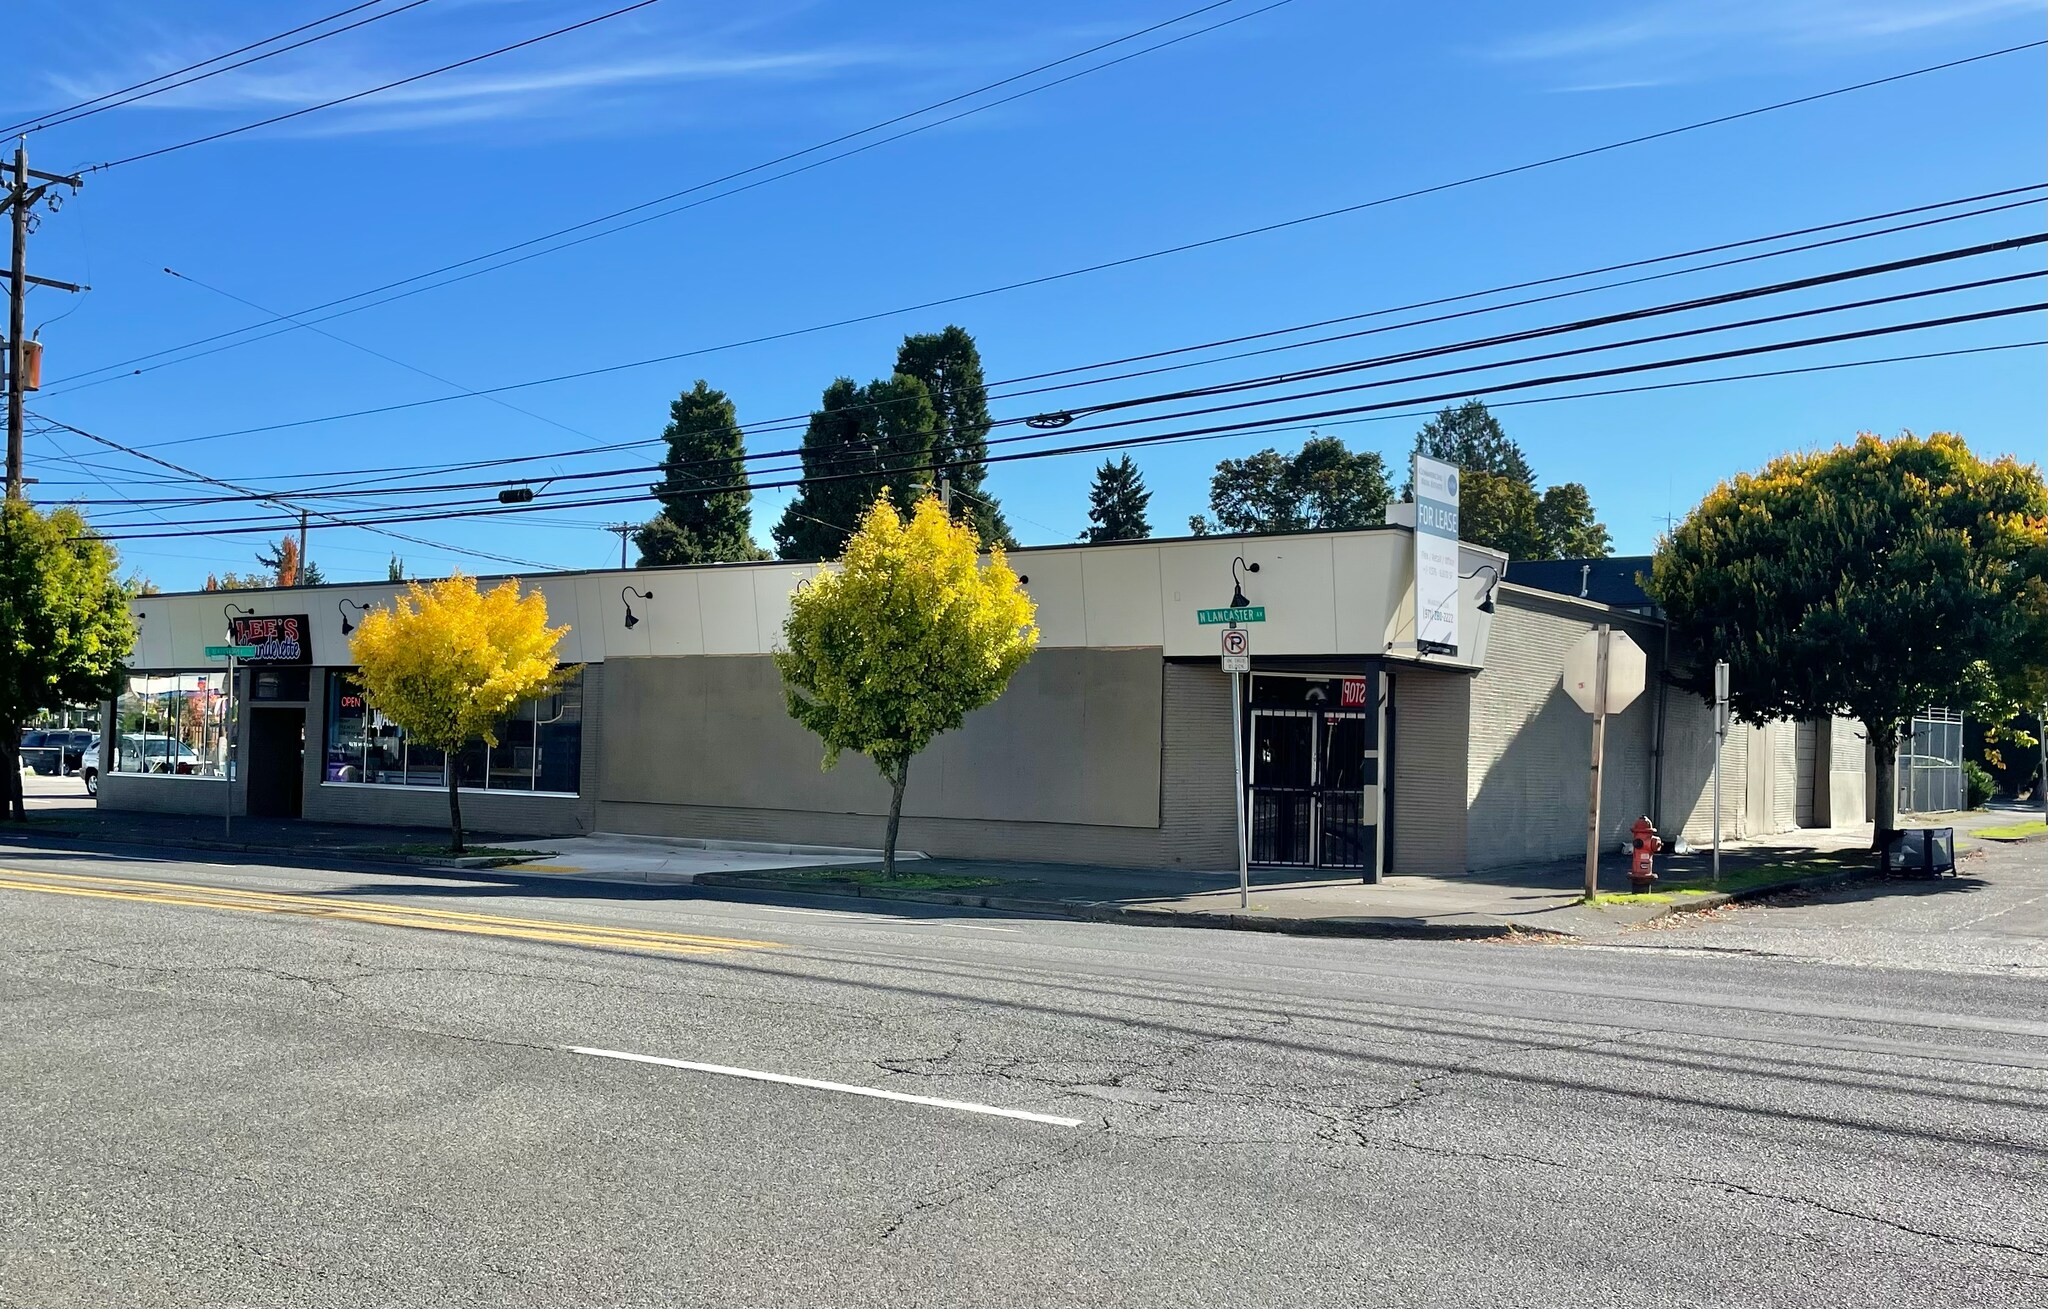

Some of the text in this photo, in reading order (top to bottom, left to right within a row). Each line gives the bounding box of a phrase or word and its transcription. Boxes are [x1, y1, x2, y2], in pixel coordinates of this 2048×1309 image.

[1419, 503, 1457, 533] FOR LEASE
[1200, 612, 1206, 623] N
[1207, 609, 1254, 622] LANCASTER
[236, 618, 299, 645] LEE'S
[341, 696, 361, 708] OPEN
